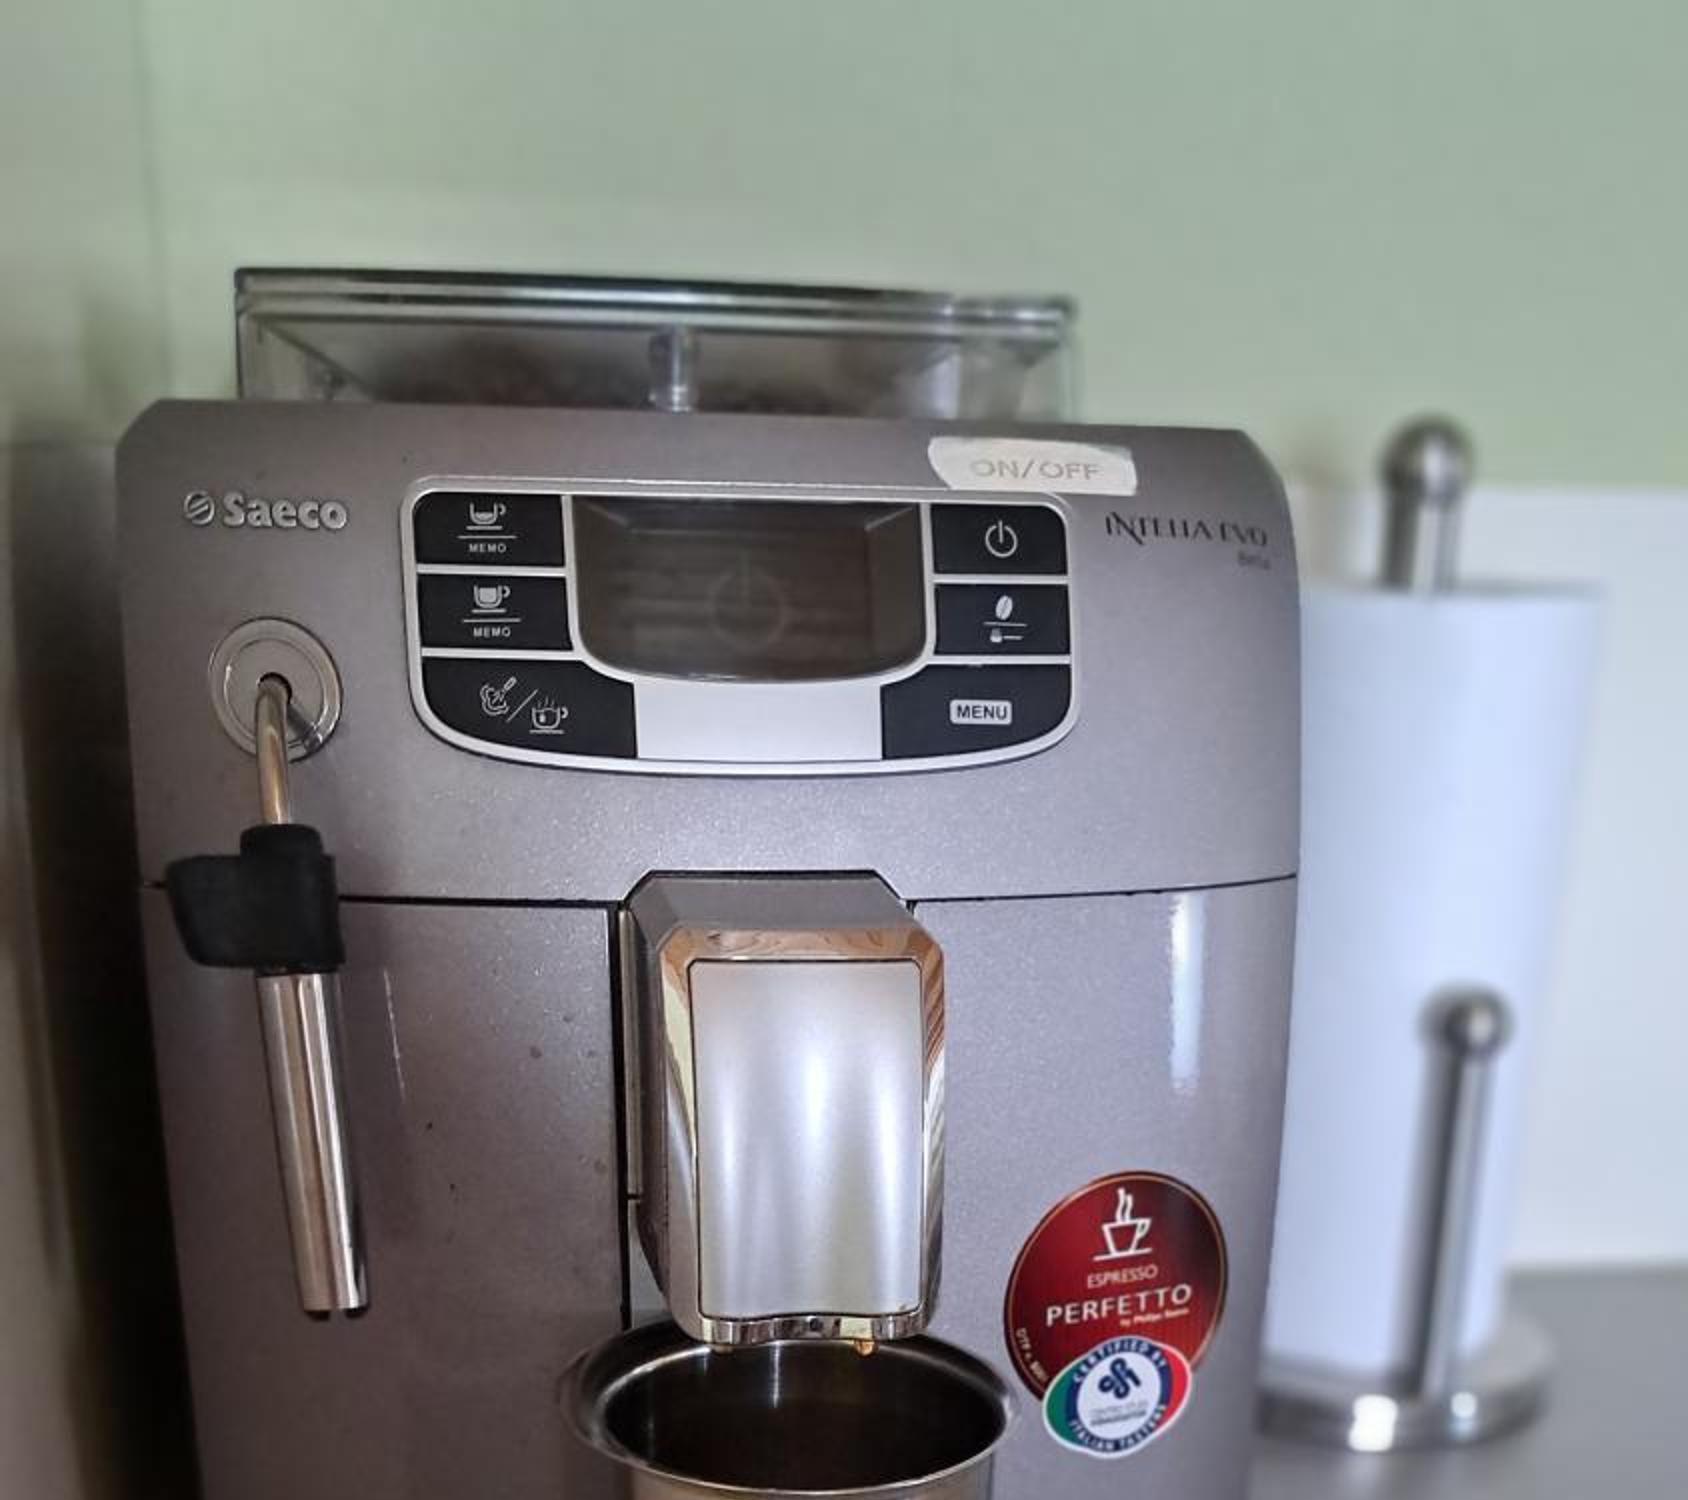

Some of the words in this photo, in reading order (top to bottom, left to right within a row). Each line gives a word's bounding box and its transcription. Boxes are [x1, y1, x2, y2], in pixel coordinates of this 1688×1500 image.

[970, 458, 1100, 481] ON/OFF
[222, 491, 348, 530] Saeco
[468, 542, 508, 554] MEMO
[472, 625, 512, 638] MEMO
[955, 704, 1009, 721] MENU
[1086, 1263, 1159, 1290] ESPRESSO
[1045, 1283, 1193, 1327] PERFETTO
